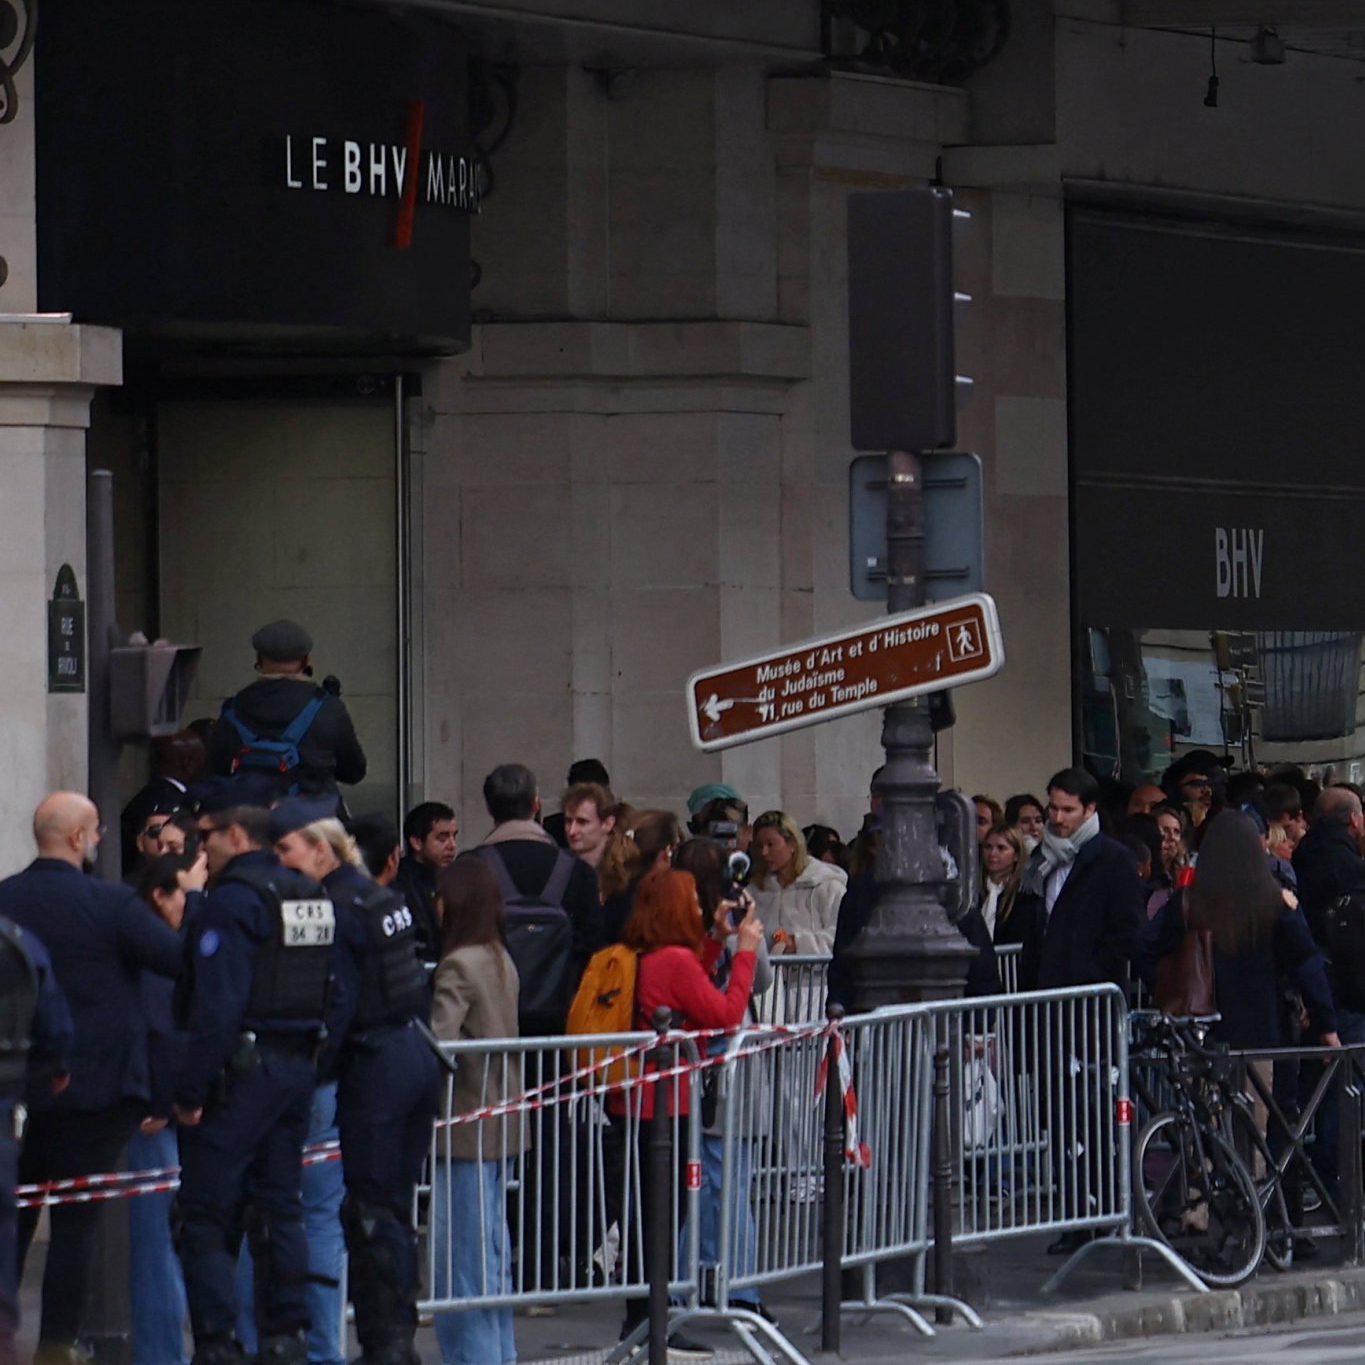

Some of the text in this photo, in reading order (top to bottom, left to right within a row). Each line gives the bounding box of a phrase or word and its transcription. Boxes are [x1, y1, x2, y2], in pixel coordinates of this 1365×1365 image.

[286, 134, 329, 190] LE
[343, 140, 407, 199] BHV
[1214, 526, 1265, 600] BHV
[756, 658, 801, 685] Musée
[848, 642, 864, 659] et
[758, 668, 845, 702] du Judaïsme
[808, 689, 826, 709] du
[830, 678, 878, 701] Temple
